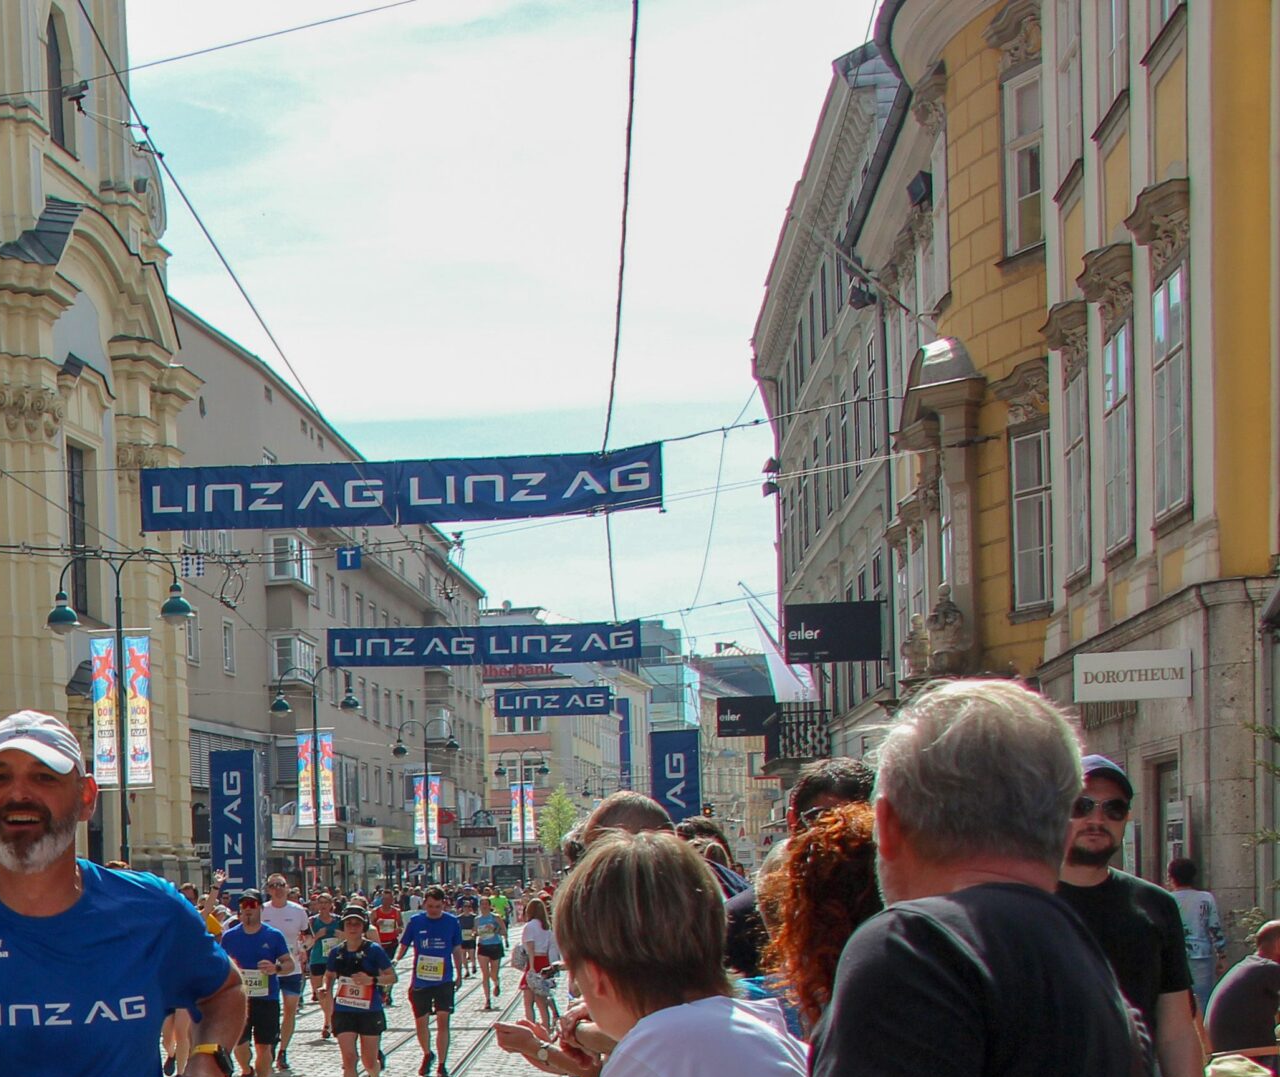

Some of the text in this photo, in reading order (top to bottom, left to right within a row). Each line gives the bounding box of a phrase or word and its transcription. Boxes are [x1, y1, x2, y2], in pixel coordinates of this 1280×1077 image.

[152, 461, 651, 514] LINZ AG LINZ AG
[342, 551, 355, 567] T
[788, 622, 820, 640] eiler
[334, 630, 635, 658] LINZ AG LINZ AG
[1083, 667, 1184, 685] DOROTHEUM
[499, 694, 605, 710] LINZ AG
[665, 752, 686, 808] AG
[223, 770, 244, 895] INZ AG
[349, 987, 360, 996] 90
[84, 995, 146, 1025] AG
